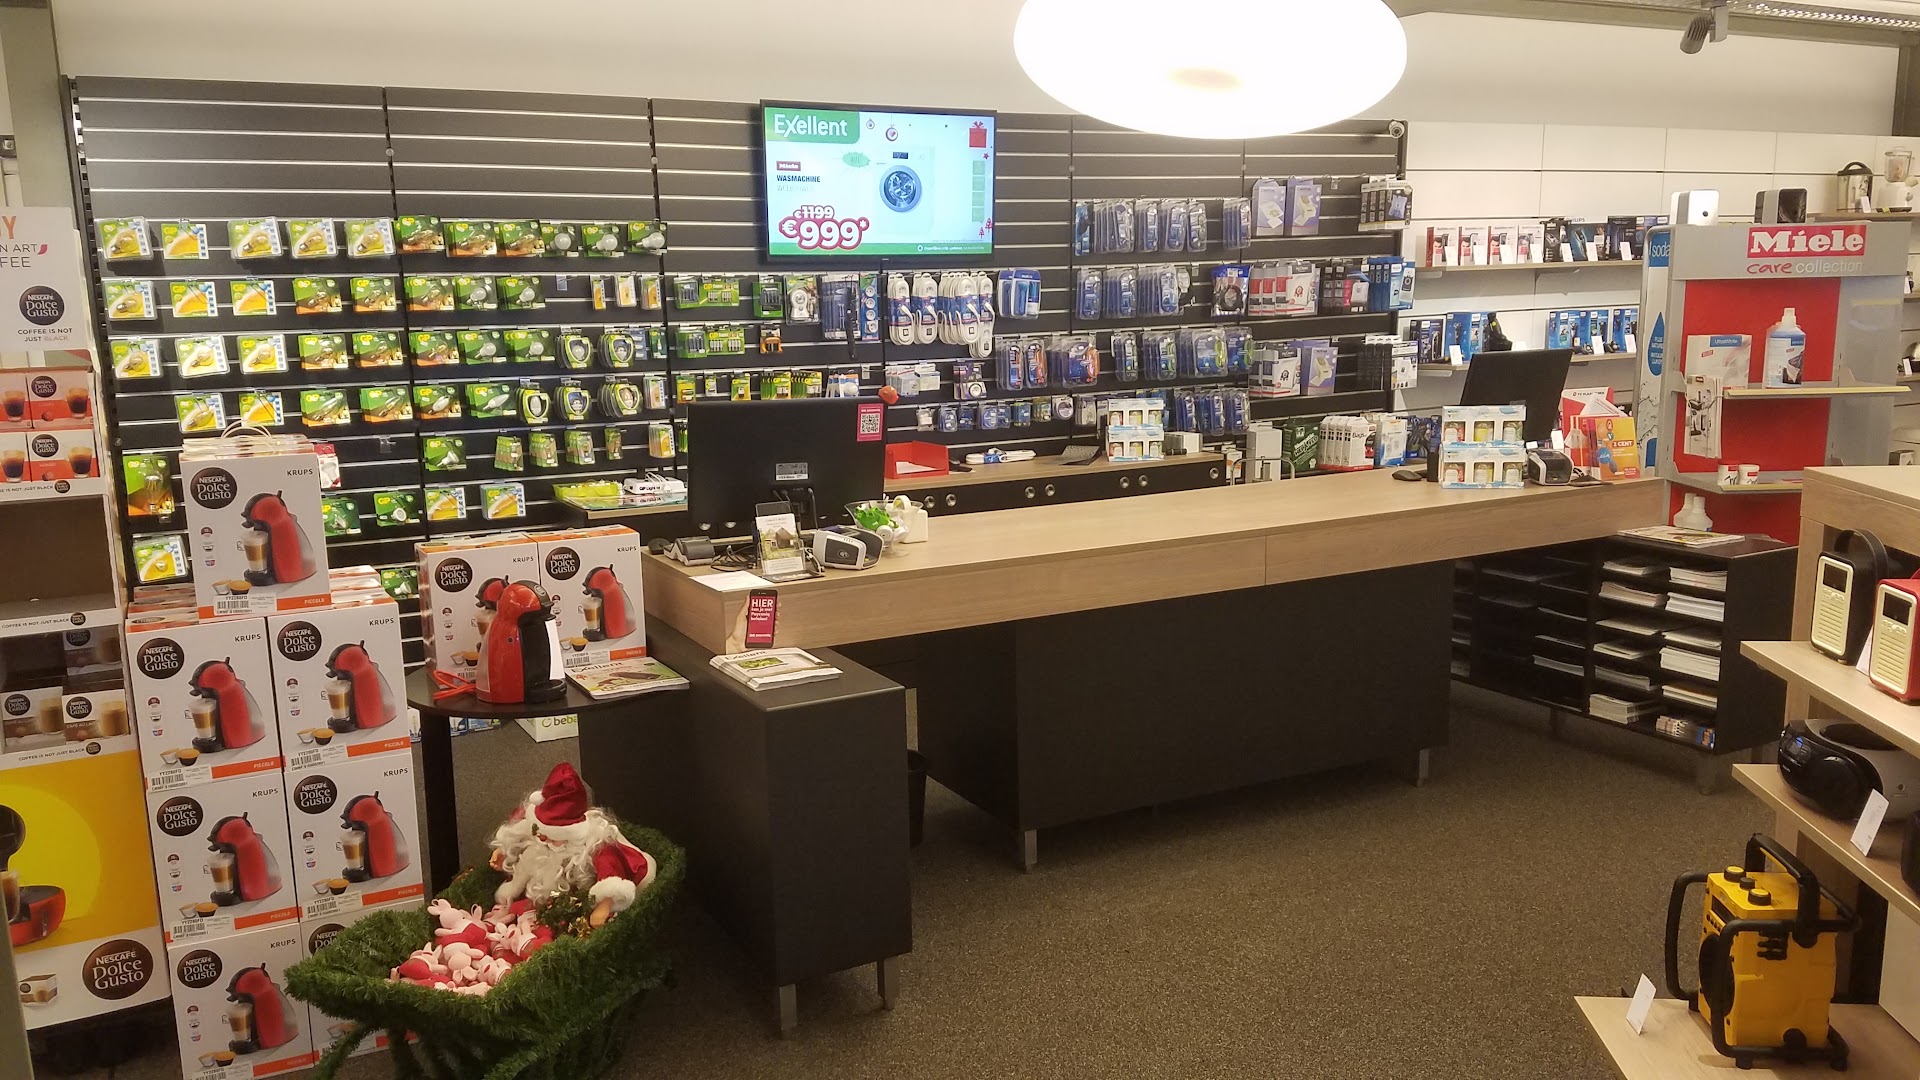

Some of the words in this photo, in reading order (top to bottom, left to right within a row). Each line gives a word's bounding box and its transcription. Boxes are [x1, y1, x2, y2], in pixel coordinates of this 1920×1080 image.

[774, 113, 848, 138] Exellent
[776, 174, 820, 182] WASMACHINE
[1750, 230, 1865, 254] Miele
[13, 244, 38, 252] ART
[1746, 261, 1792, 274] care
[1796, 258, 1863, 274] collection
[26, 300, 58, 310] Dolce
[27, 308, 58, 317] Gusto
[196, 483, 230, 493] Dolce
[198, 490, 231, 500] Gusto
[550, 559, 575, 567] Dolce
[440, 570, 467, 580] Dolce
[551, 566, 575, 574] Gusto
[441, 577, 468, 586] Gusto
[751, 599, 774, 607] HIER
[235, 634, 261, 642] KRUPS
[283, 636, 315, 647] Dolce
[284, 644, 316, 654] Gusto
[143, 653, 177, 664] Dolce
[145, 661, 178, 672] Gusto
[384, 768, 408, 777] KRUPS
[252, 788, 278, 797] KRUPS
[300, 789, 330, 801] Dolce
[301, 797, 331, 807] Gusto
[163, 810, 196, 822] Dolce
[164, 819, 197, 830] Gusto
[270, 939, 296, 948] KRUPS
[92, 959, 142, 980] Dolce
[183, 962, 215, 975] Dolce
[94, 970, 144, 990] Gusto
[184, 970, 216, 982] Gusto
